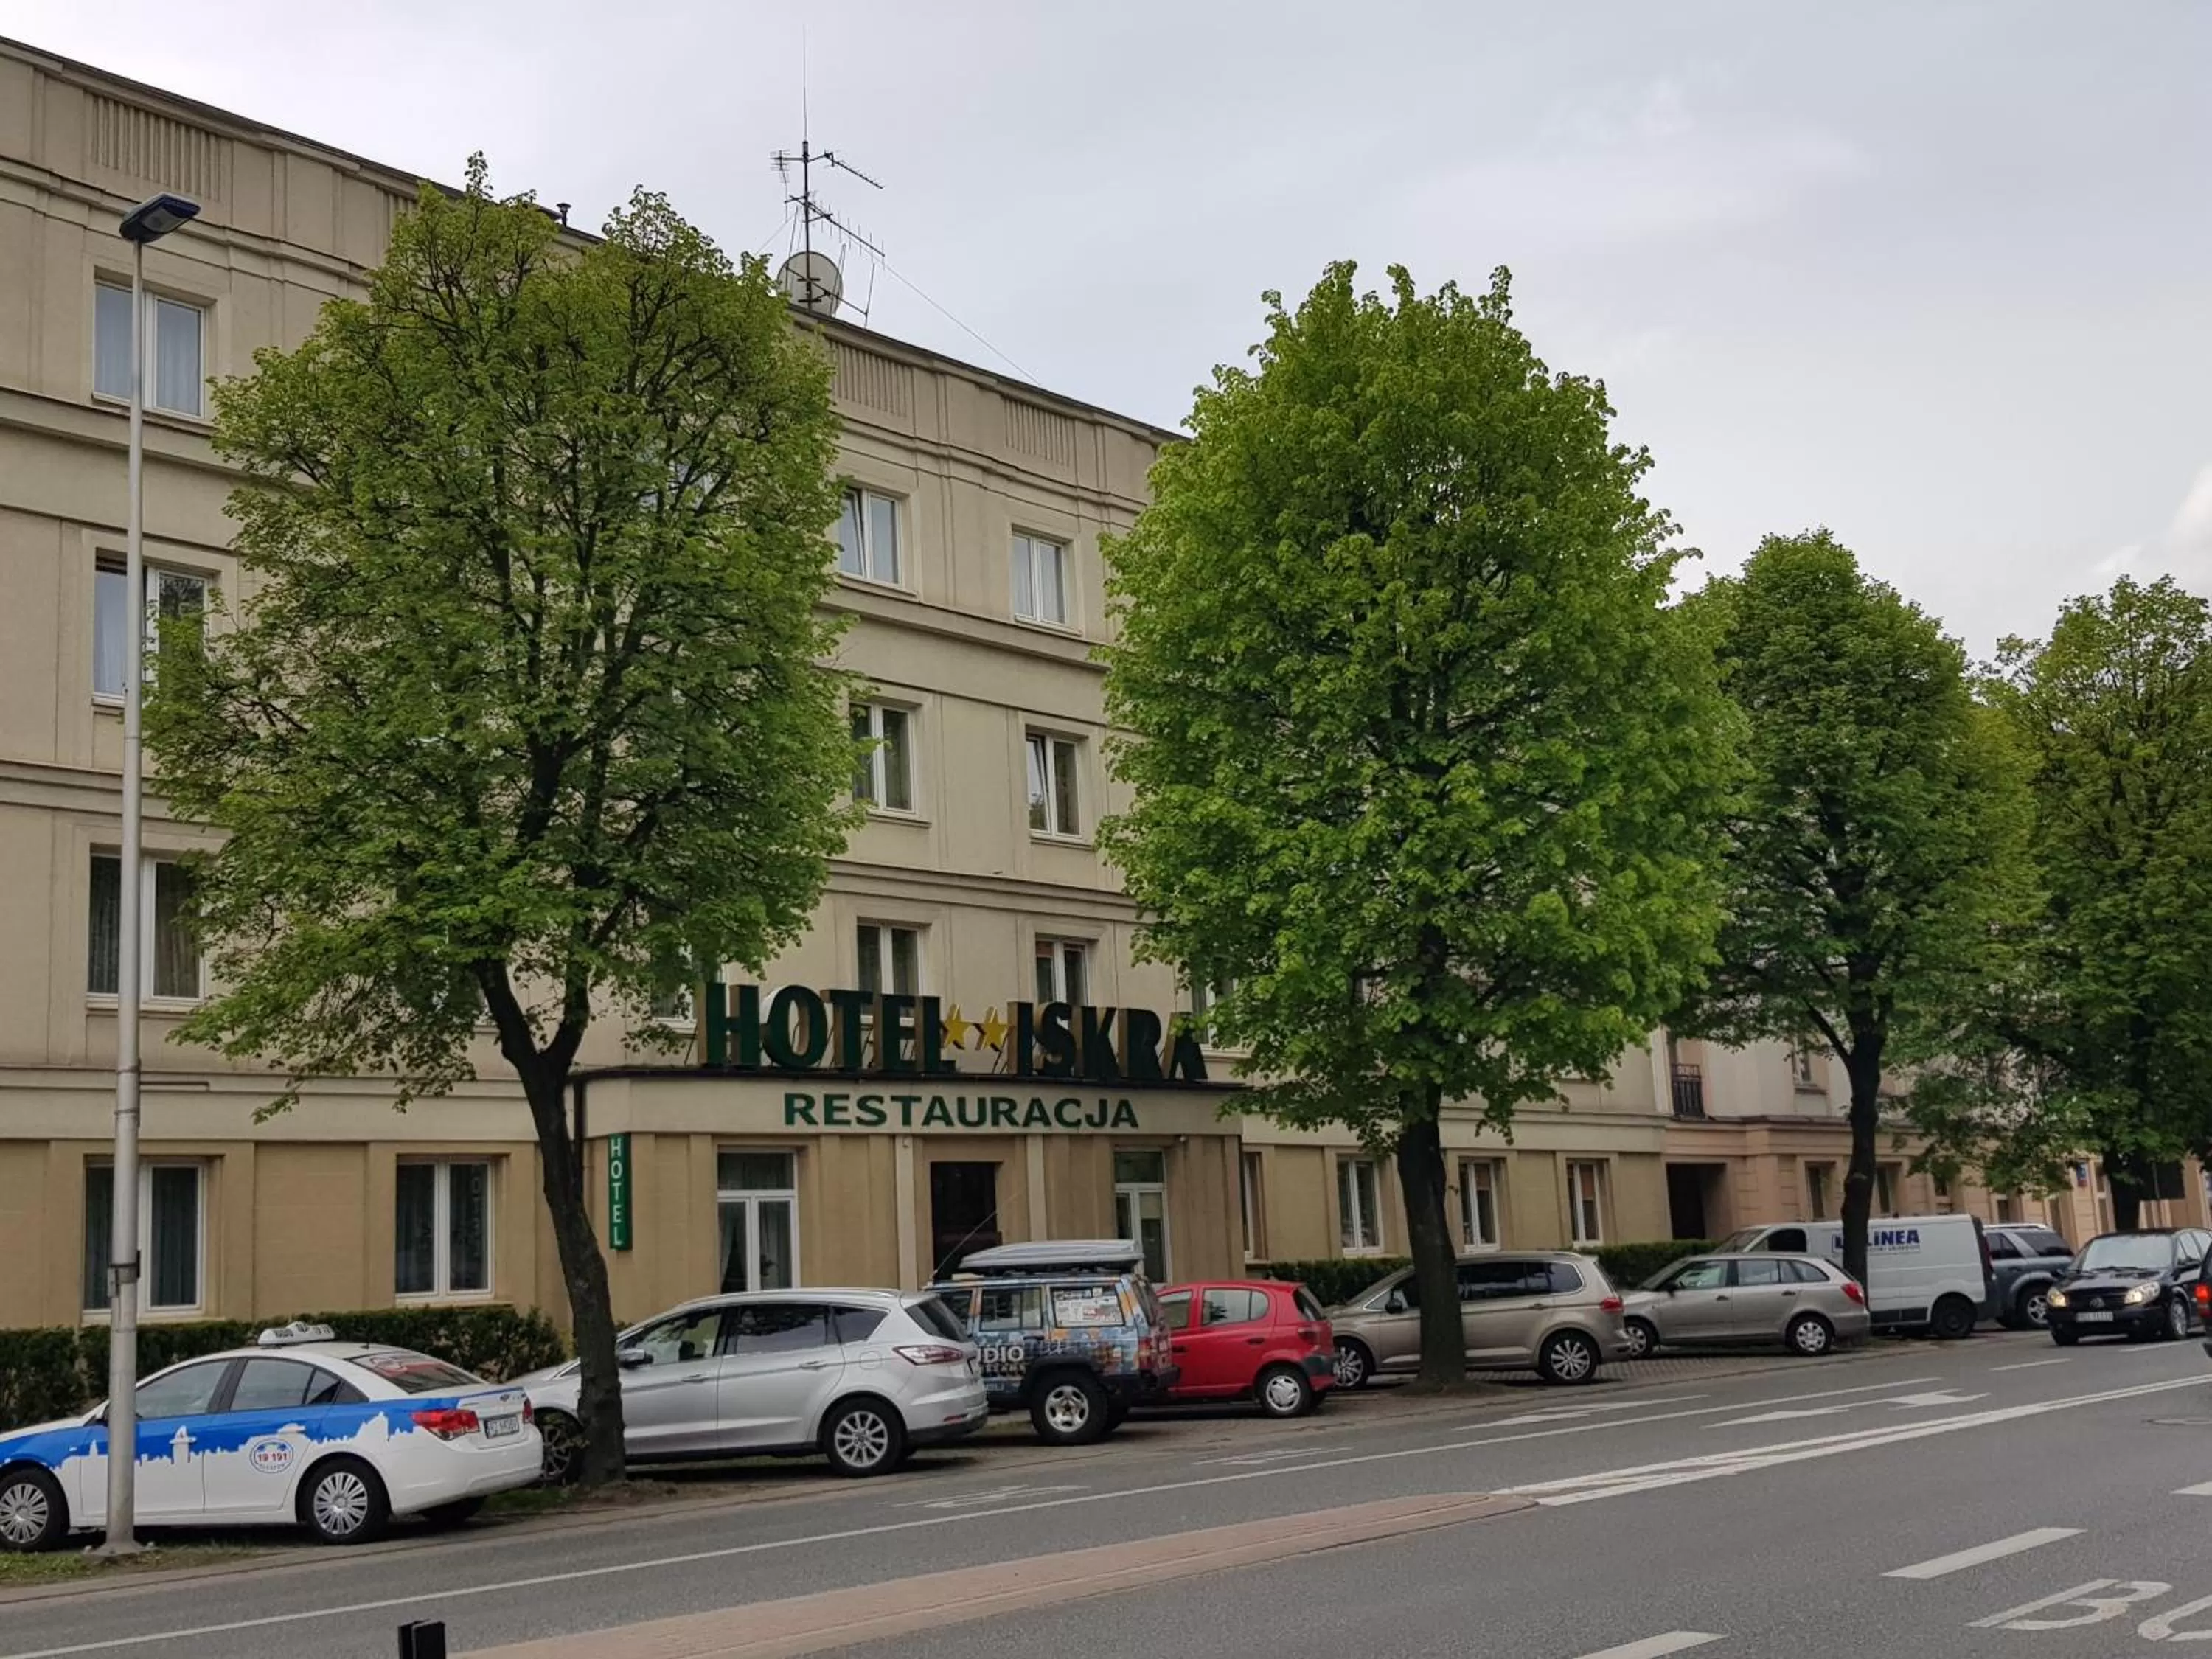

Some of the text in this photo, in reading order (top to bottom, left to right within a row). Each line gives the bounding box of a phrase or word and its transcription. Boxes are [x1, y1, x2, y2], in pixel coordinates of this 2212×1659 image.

[698, 982, 1208, 1080] HOTEL ISKRA
[784, 1093, 1139, 1128] RESTAURACJA
[611, 1137, 623, 1246] HOTEL
